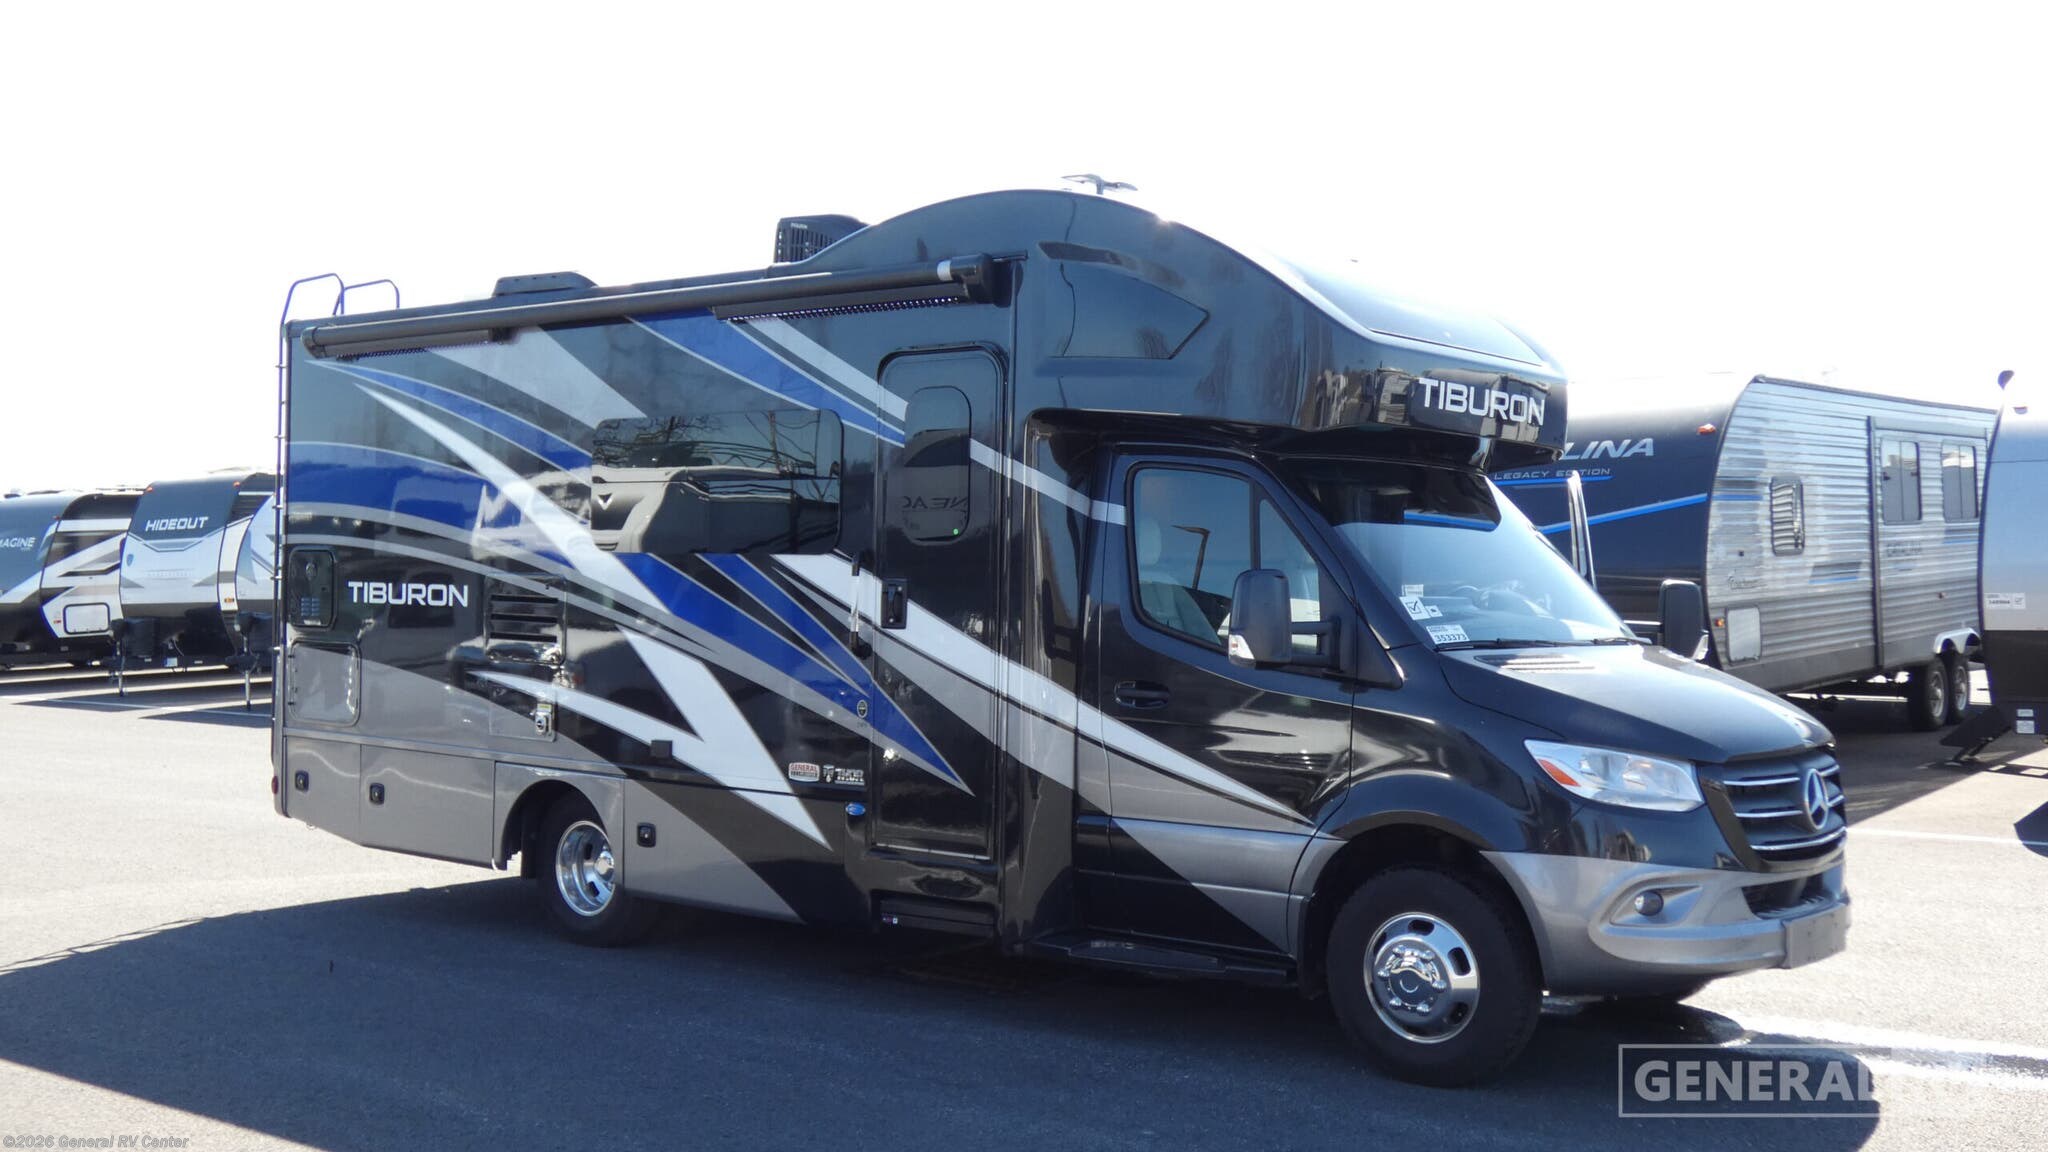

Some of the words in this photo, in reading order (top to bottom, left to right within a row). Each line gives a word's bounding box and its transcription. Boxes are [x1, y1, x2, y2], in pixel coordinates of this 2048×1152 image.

[1418, 377, 1546, 426] TIBURON
[1494, 470, 1549, 480] LEGACY
[1555, 468, 1611, 477] EDTION
[145, 516, 209, 532] HIDEOUT
[348, 581, 468, 608] TIBURON
